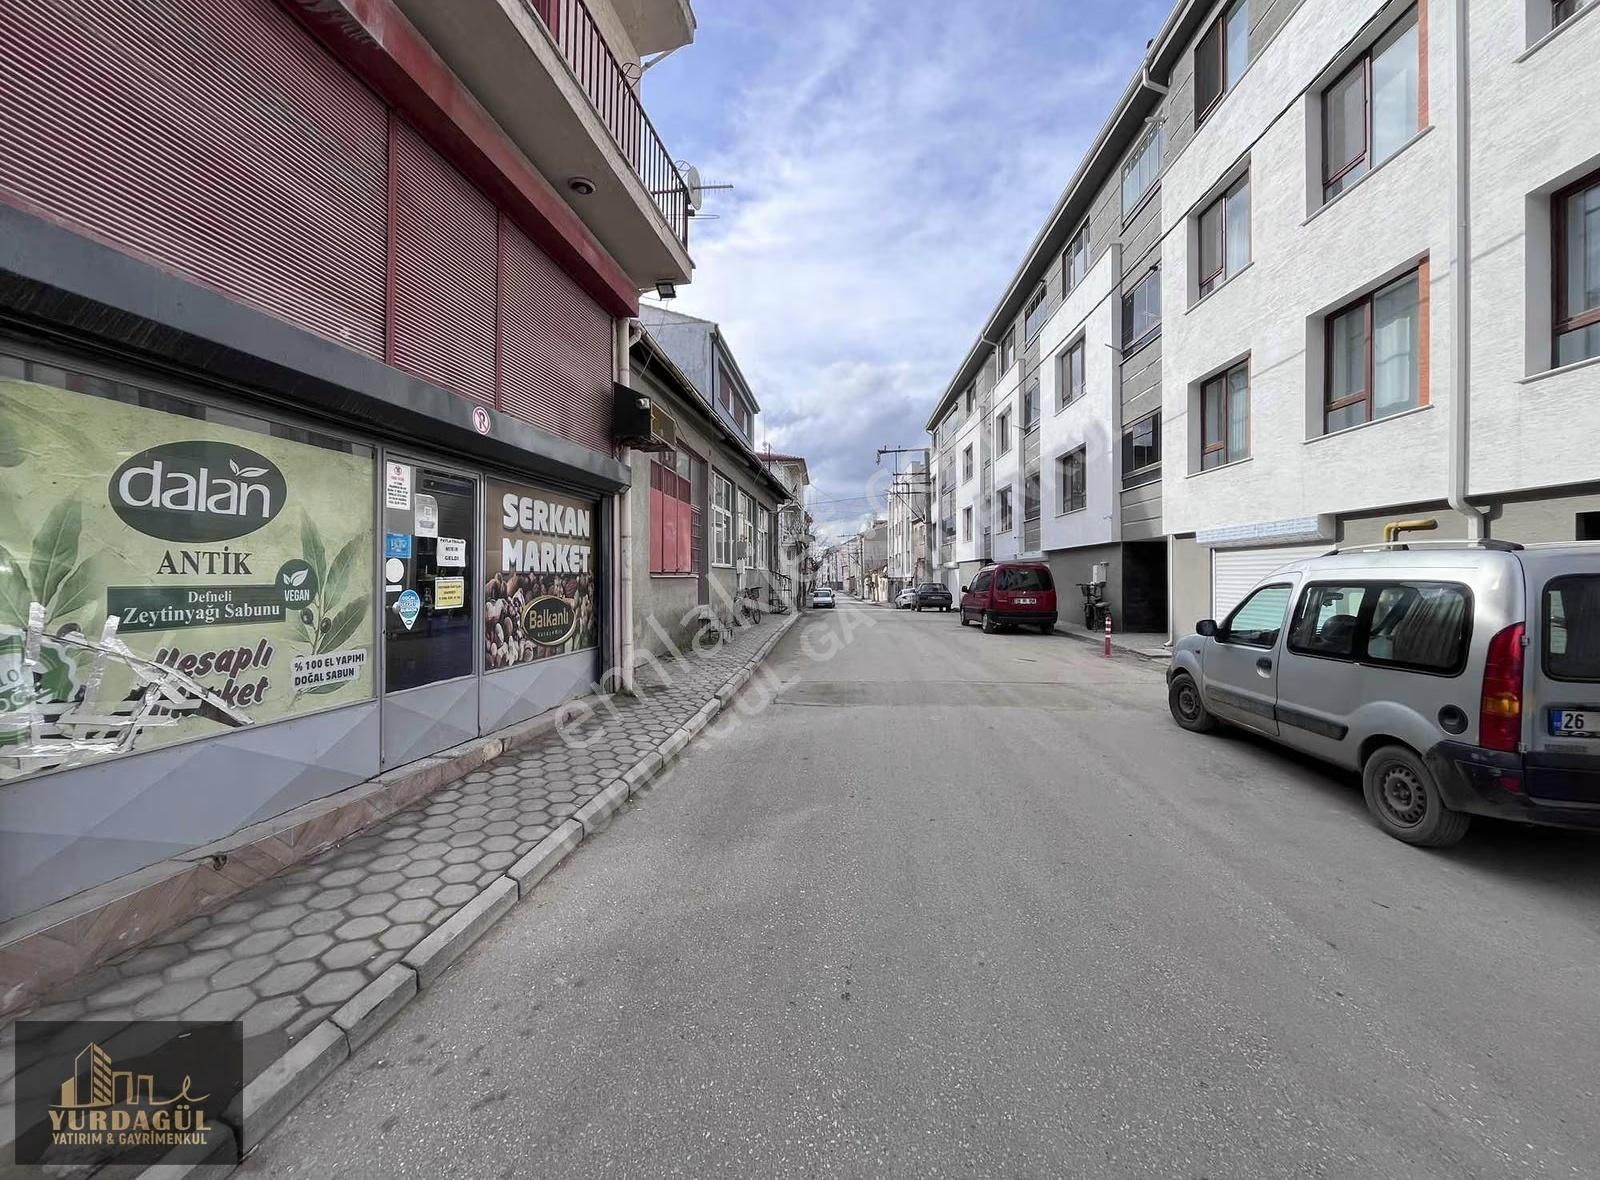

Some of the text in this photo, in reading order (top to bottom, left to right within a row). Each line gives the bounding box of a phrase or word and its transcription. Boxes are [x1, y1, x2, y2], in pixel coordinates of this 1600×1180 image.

[118, 460, 270, 518] dalan
[502, 493, 590, 538] SERKAN
[156, 546, 252, 575] ANTİK
[502, 537, 590, 573] MARKET
[188, 590, 232, 603] Defneli
[284, 589, 310, 601] VEGAN
[123, 603, 280, 629] Zeytinyağı Sabunu
[528, 607, 569, 630] Balkanlı
[324, 657, 334, 667] EL
[336, 653, 365, 666] YAPIMI
[294, 667, 355, 686] DOĞAL SABUN
[1563, 712, 1585, 730] 26
